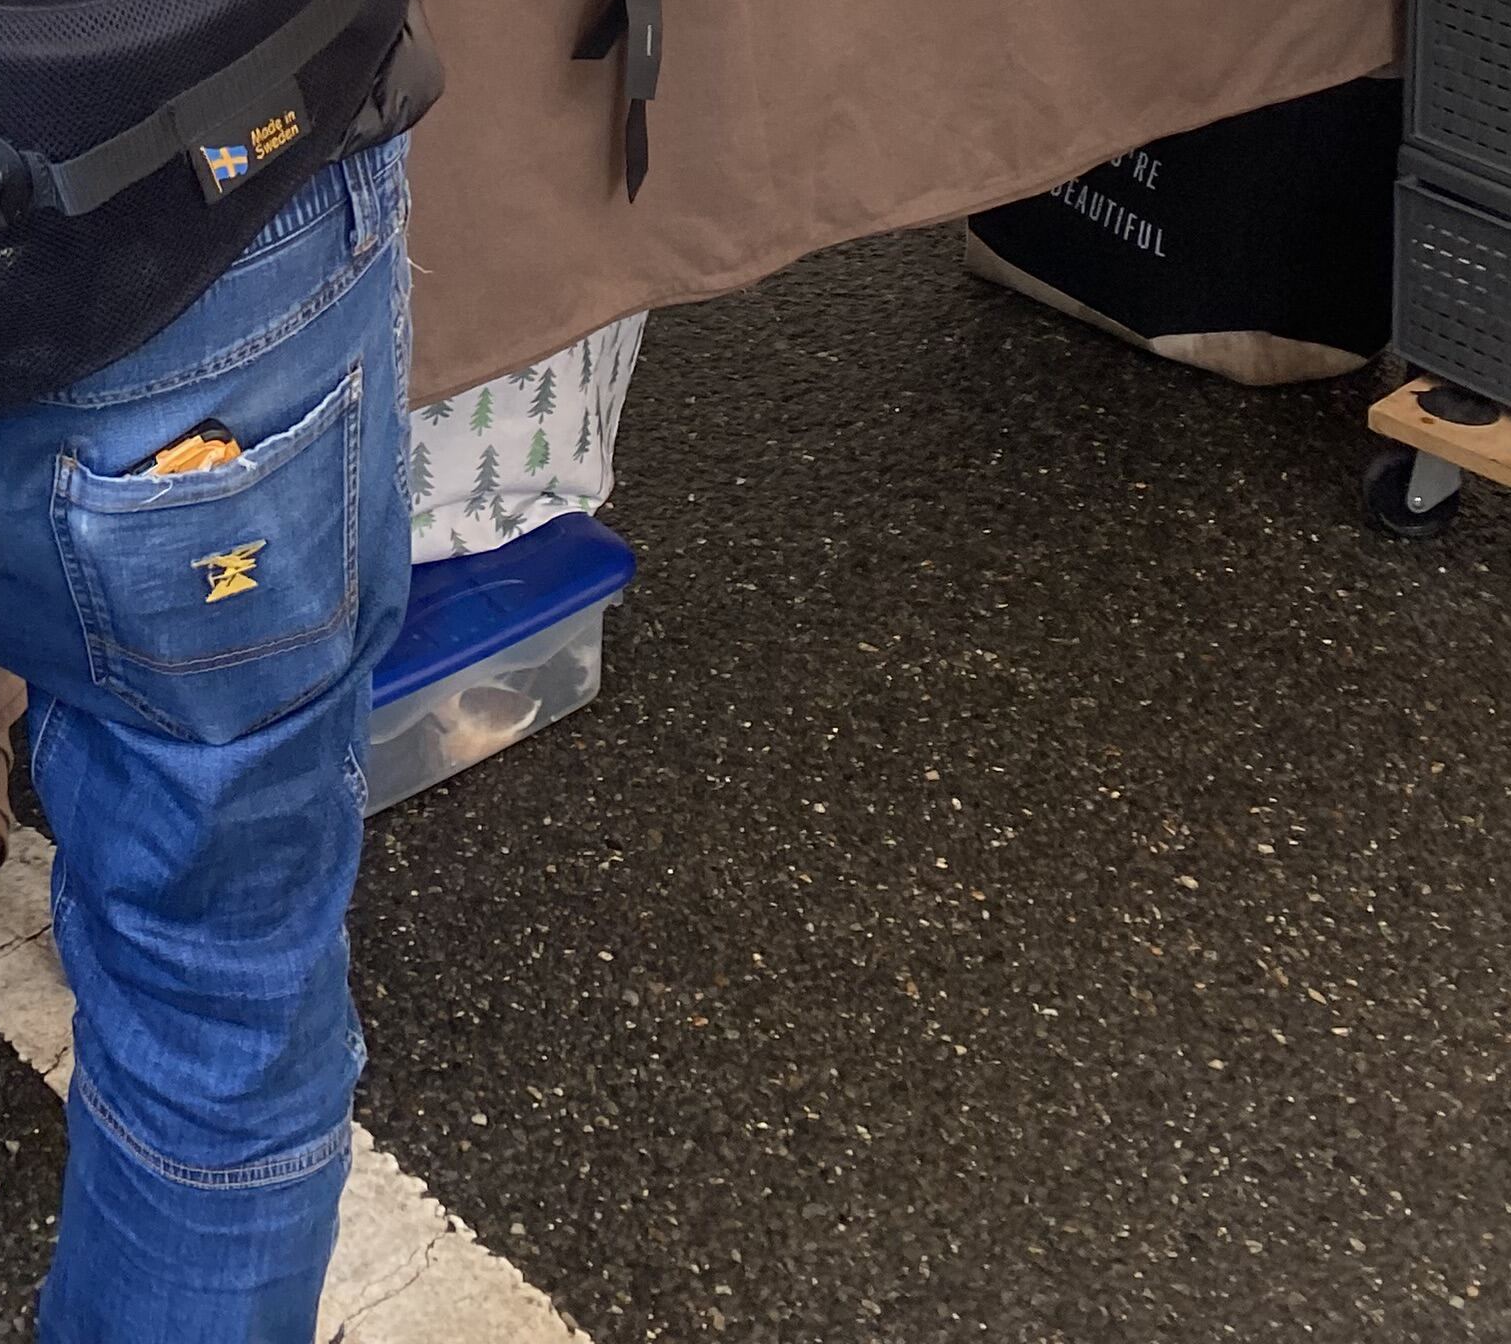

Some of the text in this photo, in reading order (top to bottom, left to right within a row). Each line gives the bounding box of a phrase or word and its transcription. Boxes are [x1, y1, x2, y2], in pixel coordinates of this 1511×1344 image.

[251, 111, 296, 147] Made in
[255, 124, 300, 160] Sweden
